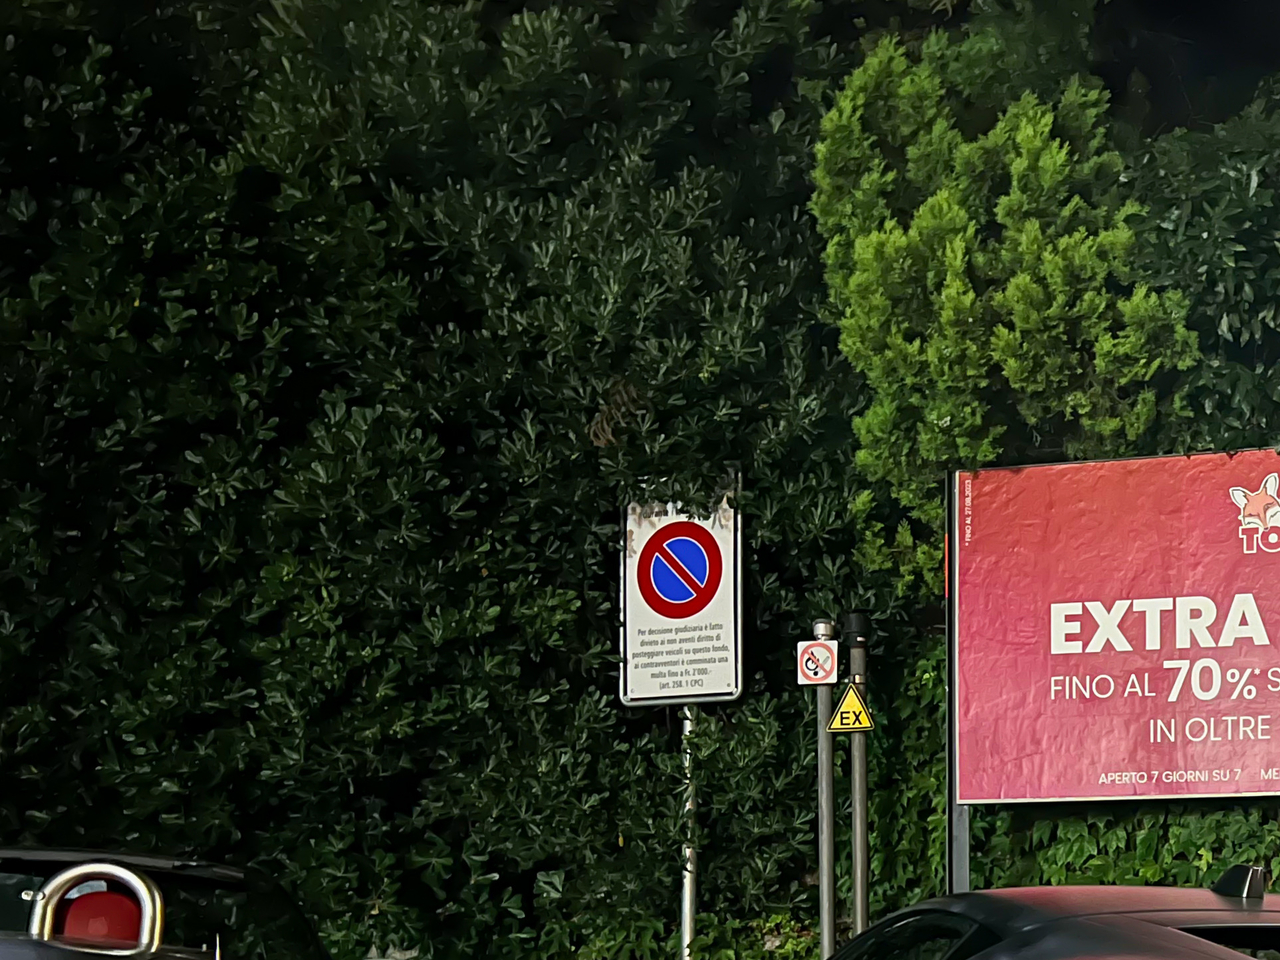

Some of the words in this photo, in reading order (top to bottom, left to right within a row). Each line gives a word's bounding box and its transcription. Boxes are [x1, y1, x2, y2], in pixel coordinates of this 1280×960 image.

[648, 626, 672, 635] decisione
[674, 624, 703, 634] giudiziaria
[1050, 593, 1271, 655] EXTRA
[678, 636, 696, 644] aventi
[697, 634, 714, 642] diritto
[632, 650, 664, 660] posteggiare
[665, 647, 683, 656] veicoli
[692, 646, 710, 654] questo
[640, 659, 680, 669] contravventori
[686, 657, 717, 665] comminata
[660, 682, 670, 690] (art.
[1050, 674, 1116, 700] FINO
[1124, 672, 1157, 697] AL
[840, 710, 863, 726] EX
[1149, 718, 1176, 743] IN
[1185, 714, 1272, 742] OLTRE
[1098, 771, 1148, 785] APERTO
[1150, 770, 1160, 783] 7
[1162, 770, 1209, 783] GIORNI
[1212, 768, 1231, 782] SU
[1232, 767, 1242, 781] 7
